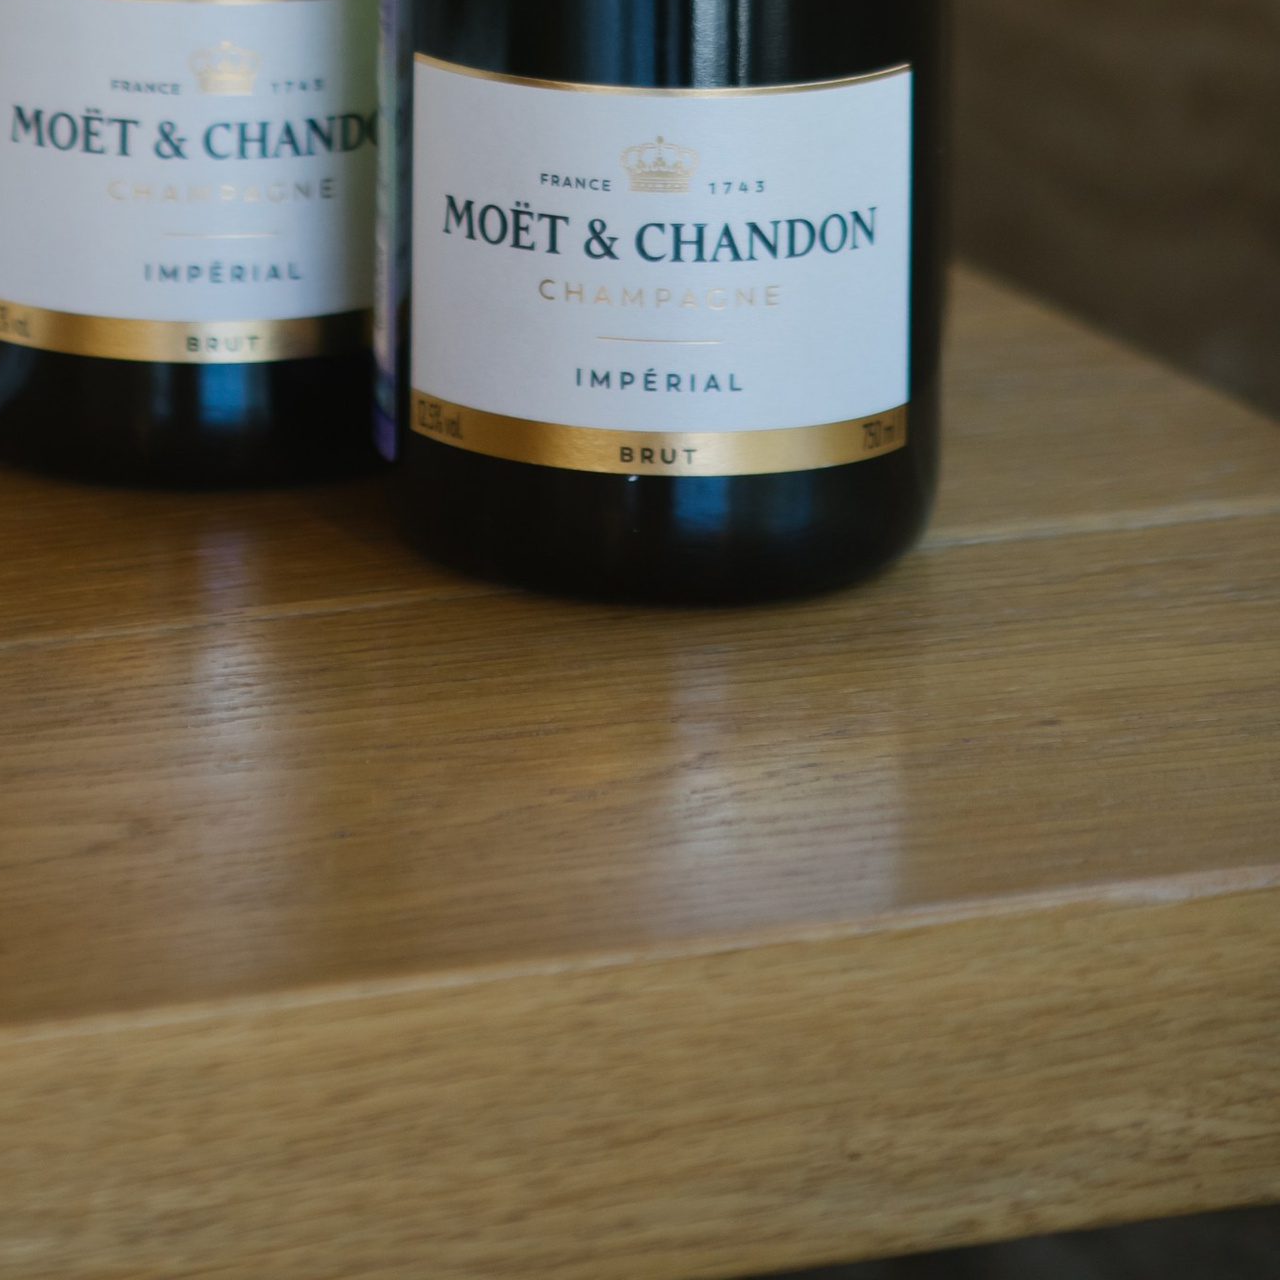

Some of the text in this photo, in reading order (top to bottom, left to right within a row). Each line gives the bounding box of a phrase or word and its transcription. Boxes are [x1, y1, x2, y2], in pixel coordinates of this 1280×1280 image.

[110, 78, 182, 96] FRANCE
[10, 104, 378, 161] MOËT & CHAND
[539, 172, 612, 192] FRANCE
[707, 179, 766, 195] 1743
[442, 194, 878, 263] MOËT & CHANDON
[143, 260, 304, 285] IMPÉRIAL
[537, 278, 781, 311] CHAMPAGNE
[186, 334, 260, 353] BRUT
[575, 366, 744, 393] IMPÉRIAL
[619, 445, 698, 466] BRUT
